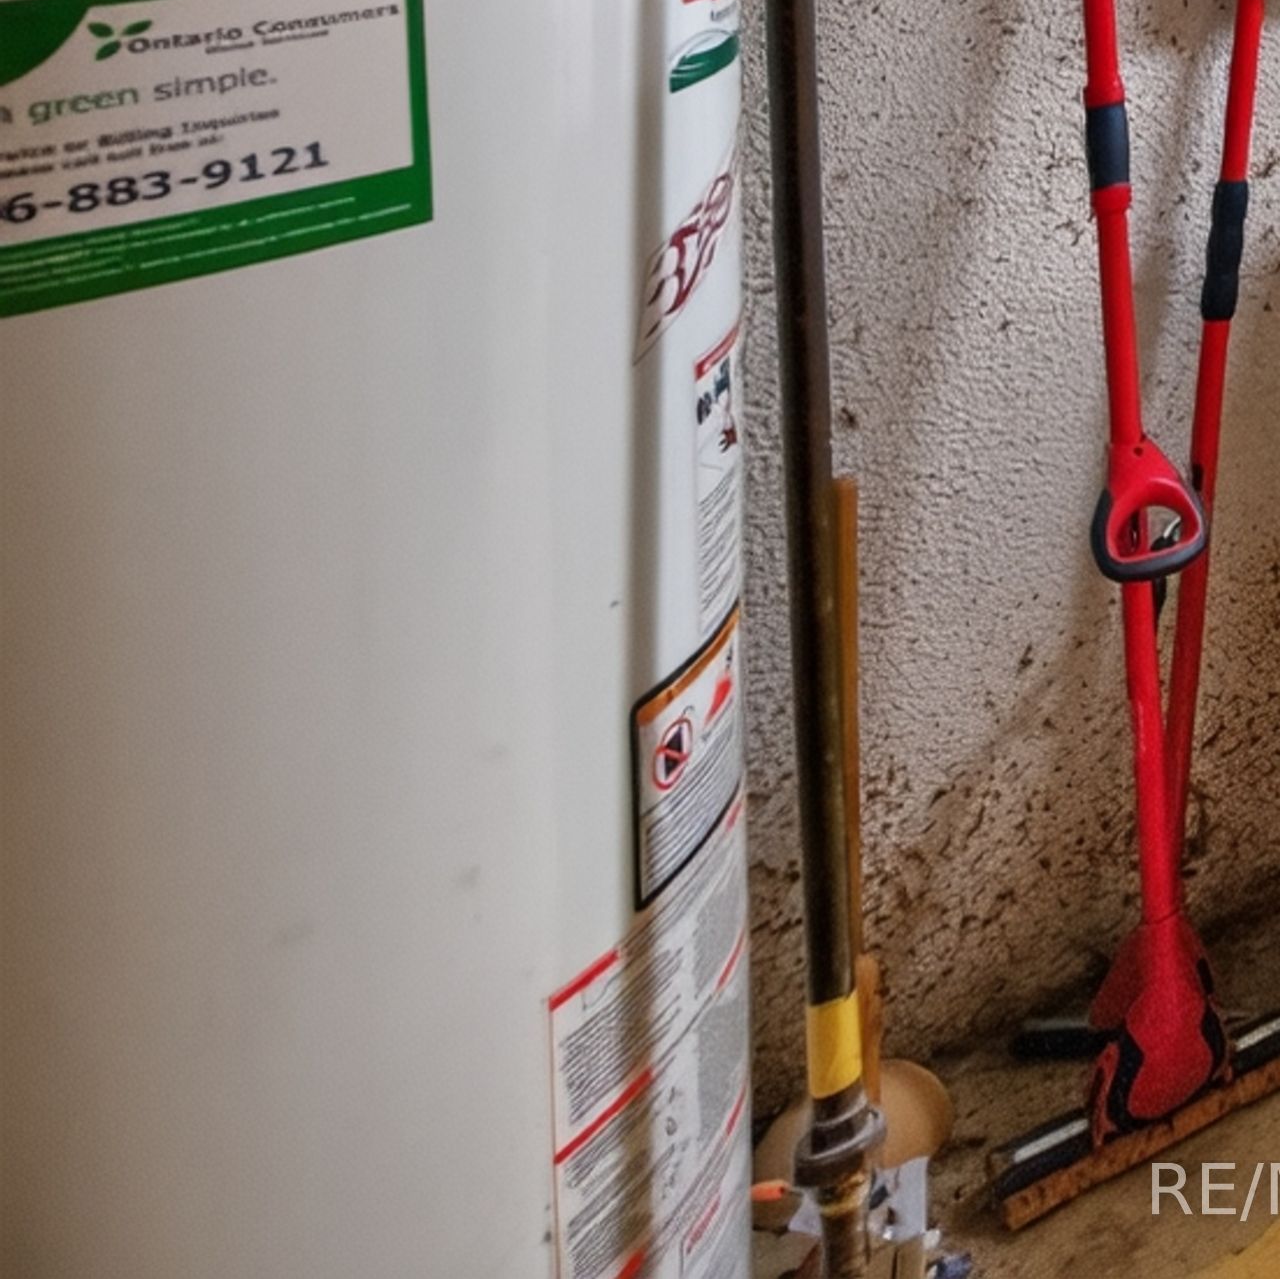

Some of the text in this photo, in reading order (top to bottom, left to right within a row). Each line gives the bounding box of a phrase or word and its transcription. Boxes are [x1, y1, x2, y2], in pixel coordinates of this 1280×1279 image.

[127, 25, 243, 55] Ontario
[252, 3, 400, 37] Consumers
[28, 87, 140, 126] green
[153, 67, 278, 102] simple.
[0, 141, 330, 223] 6-883-9121
